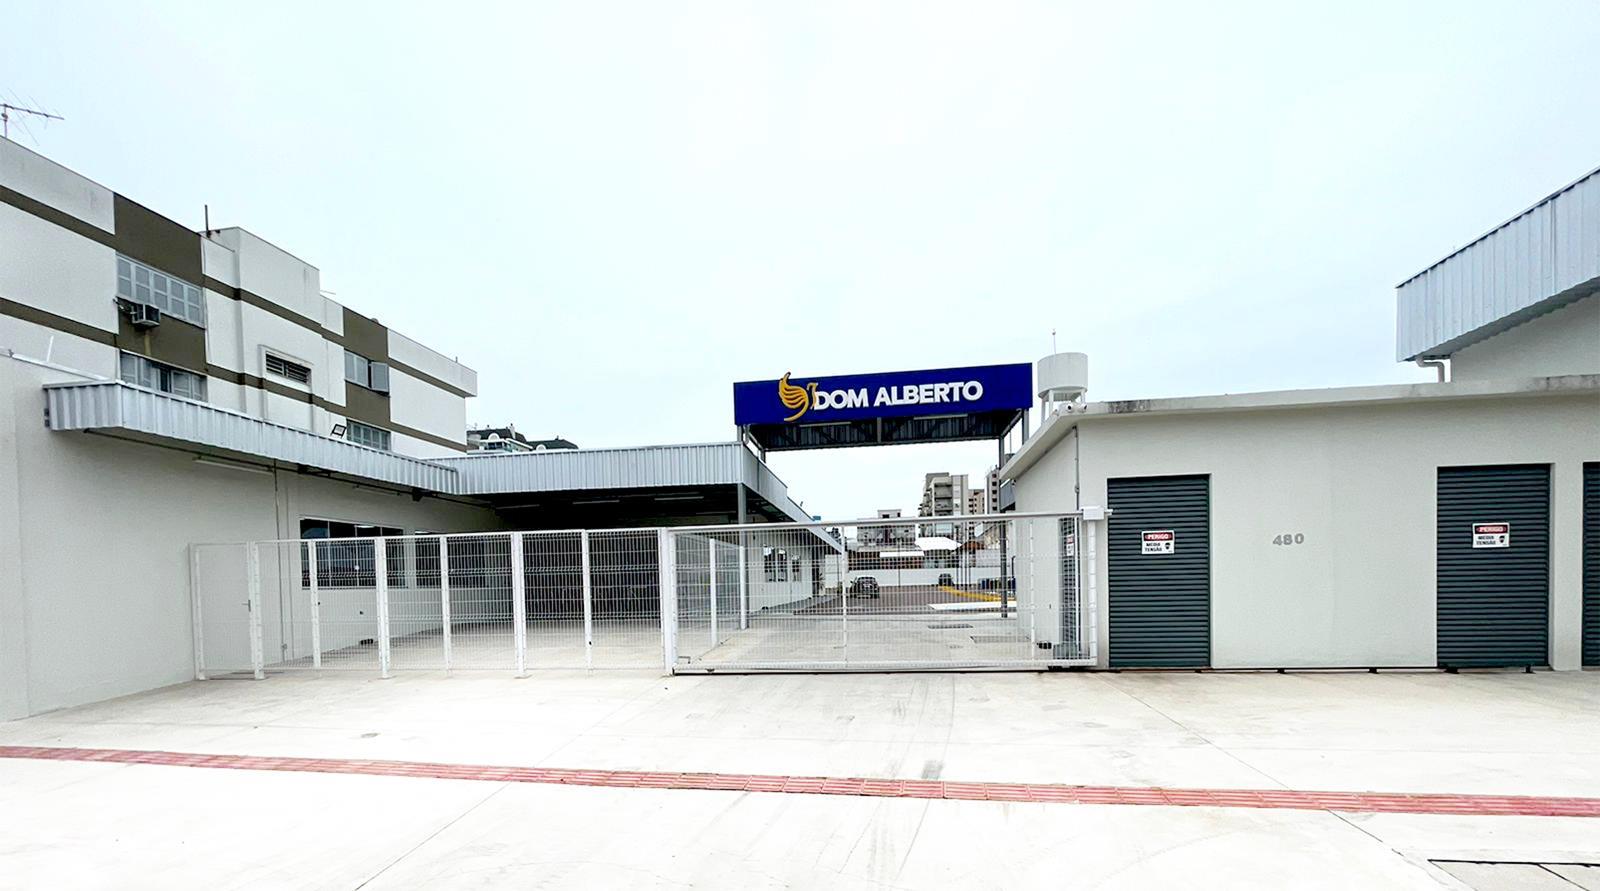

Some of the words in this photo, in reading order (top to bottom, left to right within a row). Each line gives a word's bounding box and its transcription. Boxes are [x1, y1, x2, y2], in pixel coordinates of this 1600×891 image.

[813, 388, 869, 411] DOM
[874, 380, 984, 407] ALBERTO
[1272, 533, 1305, 546] 480
